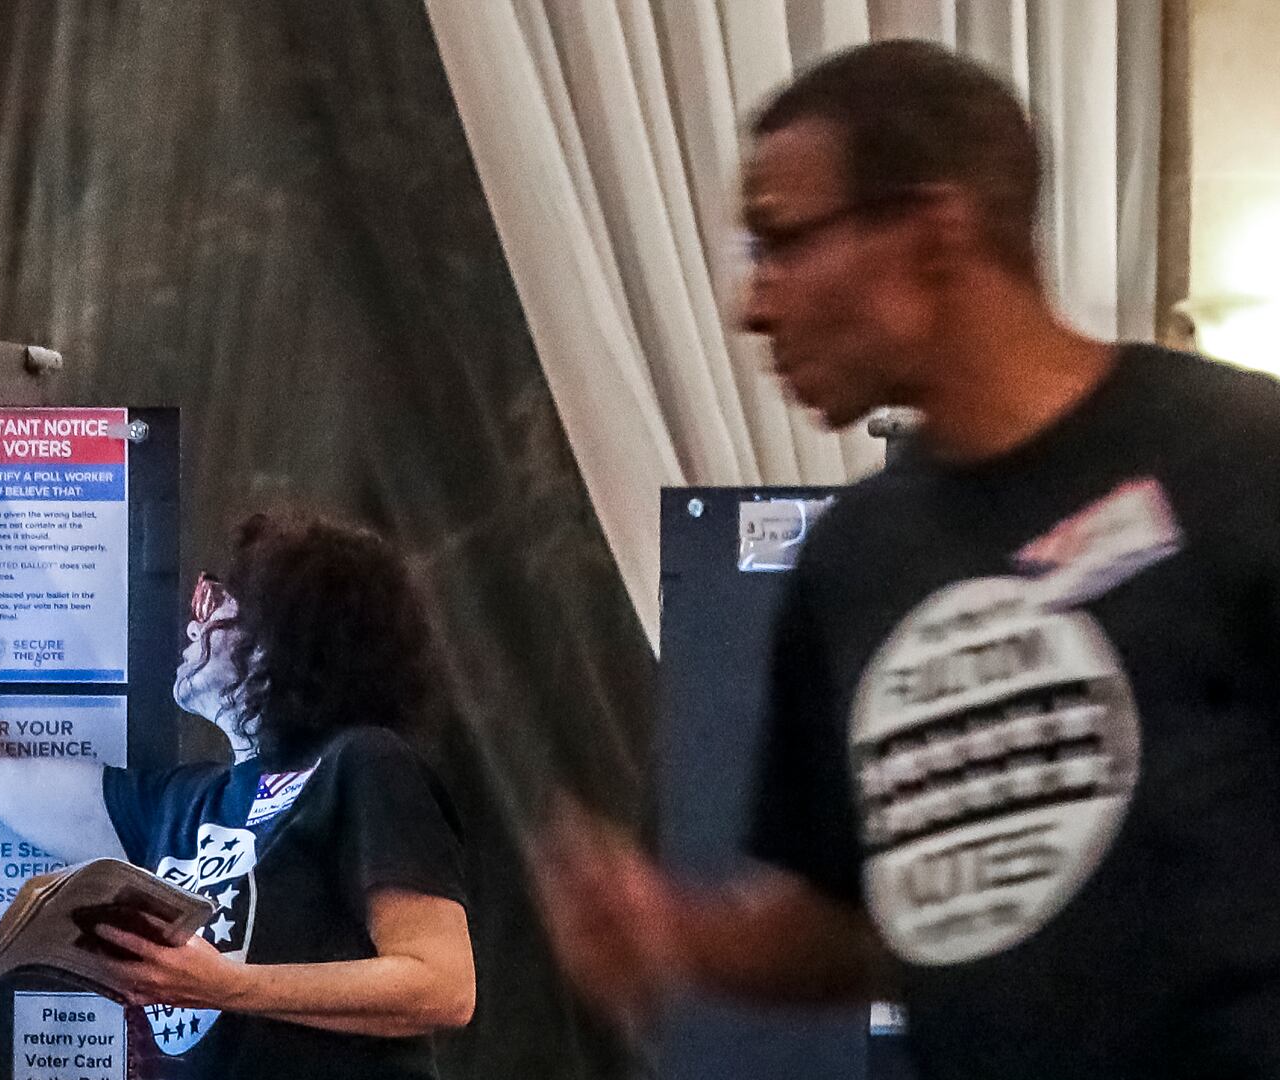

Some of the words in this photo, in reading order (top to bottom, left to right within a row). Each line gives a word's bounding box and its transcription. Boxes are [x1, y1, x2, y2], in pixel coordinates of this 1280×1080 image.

[45, 419, 109, 436] NOTICE
[3, 441, 72, 457] VOTERS
[24, 472, 31, 482] A
[34, 472, 61, 482] POLL
[65, 472, 113, 482] WORKER
[5, 487, 49, 496] BELIEVE
[4, 511, 26, 519] given
[44, 511, 70, 519] wrong
[30, 543, 69, 552] operating
[26, 592, 44, 600] your
[13, 602, 30, 611] your
[33, 602, 51, 610] vote
[54, 602, 68, 610] has
[70, 602, 91, 610] been
[13, 640, 64, 650] SECURE
[13, 652, 33, 660] THE
[17, 721, 73, 736] YOUR
[1, 741, 97, 758] ENIENCE,
[42, 1008, 96, 1022] Please
[23, 1032, 72, 1044] return
[78, 1034, 114, 1048] your
[25, 1054, 69, 1068] Voter
[74, 1055, 112, 1068] Card
